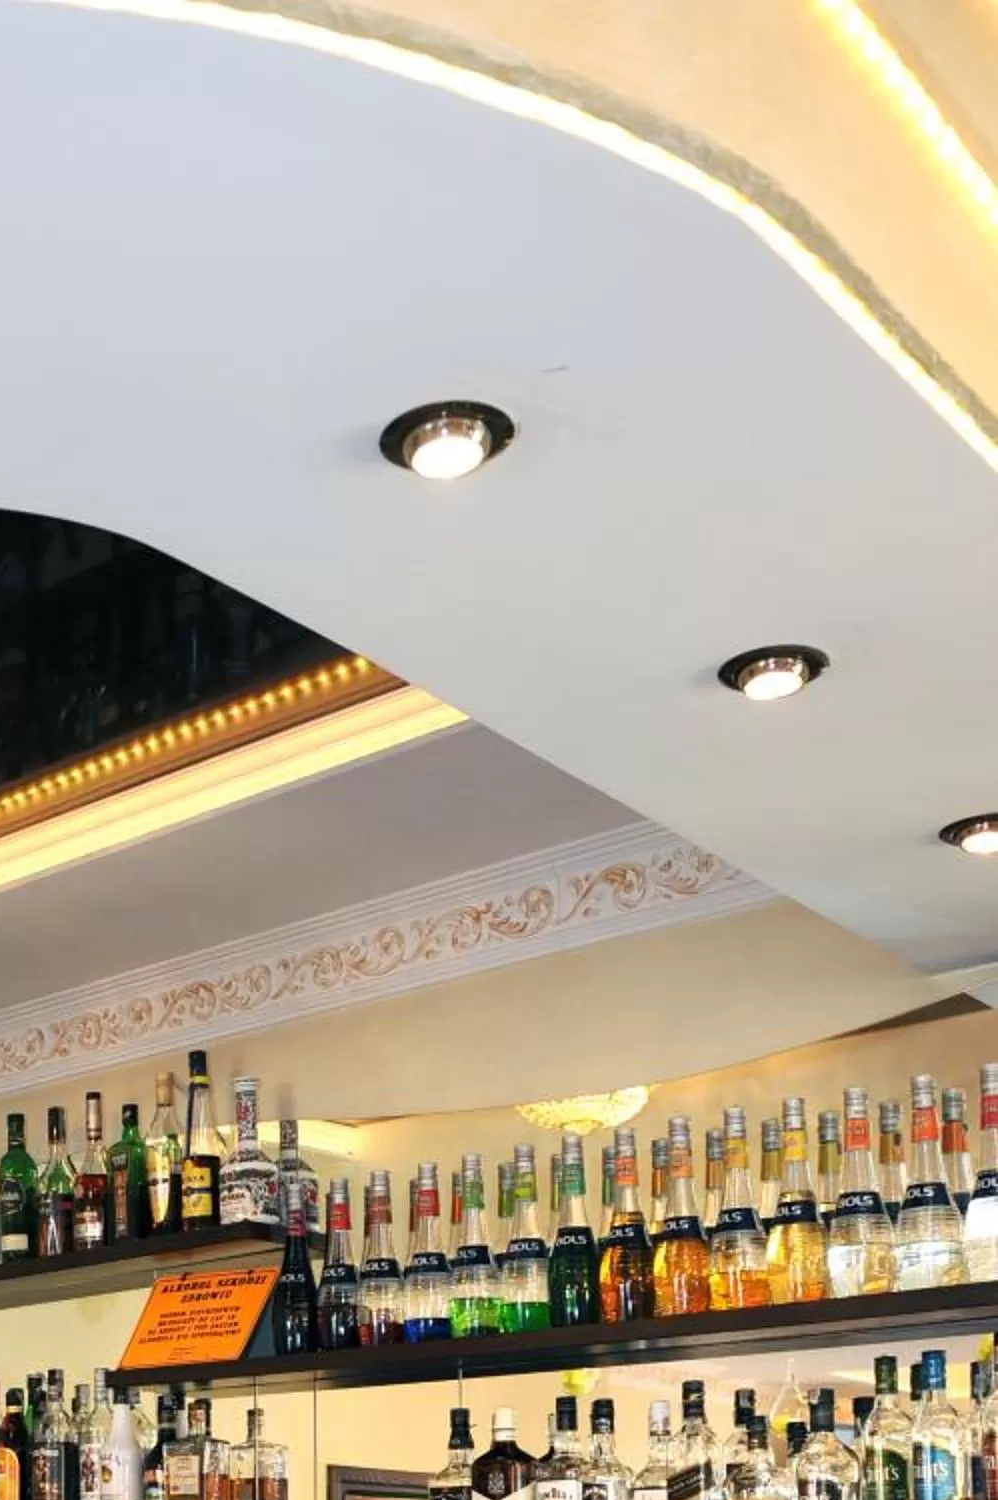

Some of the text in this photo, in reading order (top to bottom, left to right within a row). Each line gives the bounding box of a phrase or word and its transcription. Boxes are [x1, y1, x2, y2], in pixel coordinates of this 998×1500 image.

[977, 1177, 998, 1190] OL
[907, 1187, 935, 1199] OLS
[776, 1205, 802, 1217] OLS
[664, 1220, 689, 1230] OLS
[610, 1228, 635, 1238] OLS
